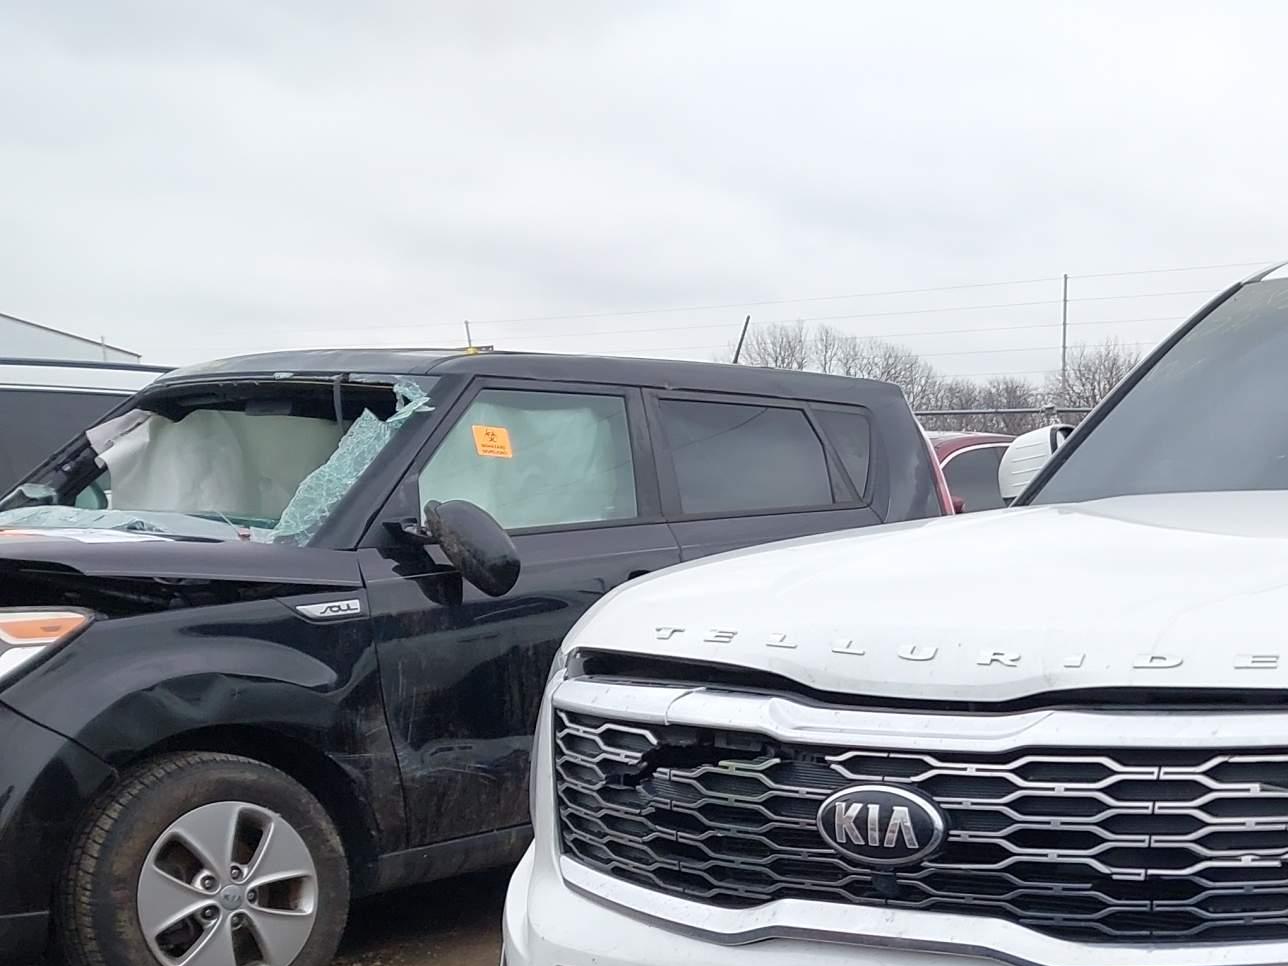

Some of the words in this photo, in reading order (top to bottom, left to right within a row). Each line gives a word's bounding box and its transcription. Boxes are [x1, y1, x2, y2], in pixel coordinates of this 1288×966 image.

[320, 603, 359, 615] SOUL
[653, 626, 1282, 670] TELLURIDE
[834, 801, 920, 849] KIA
